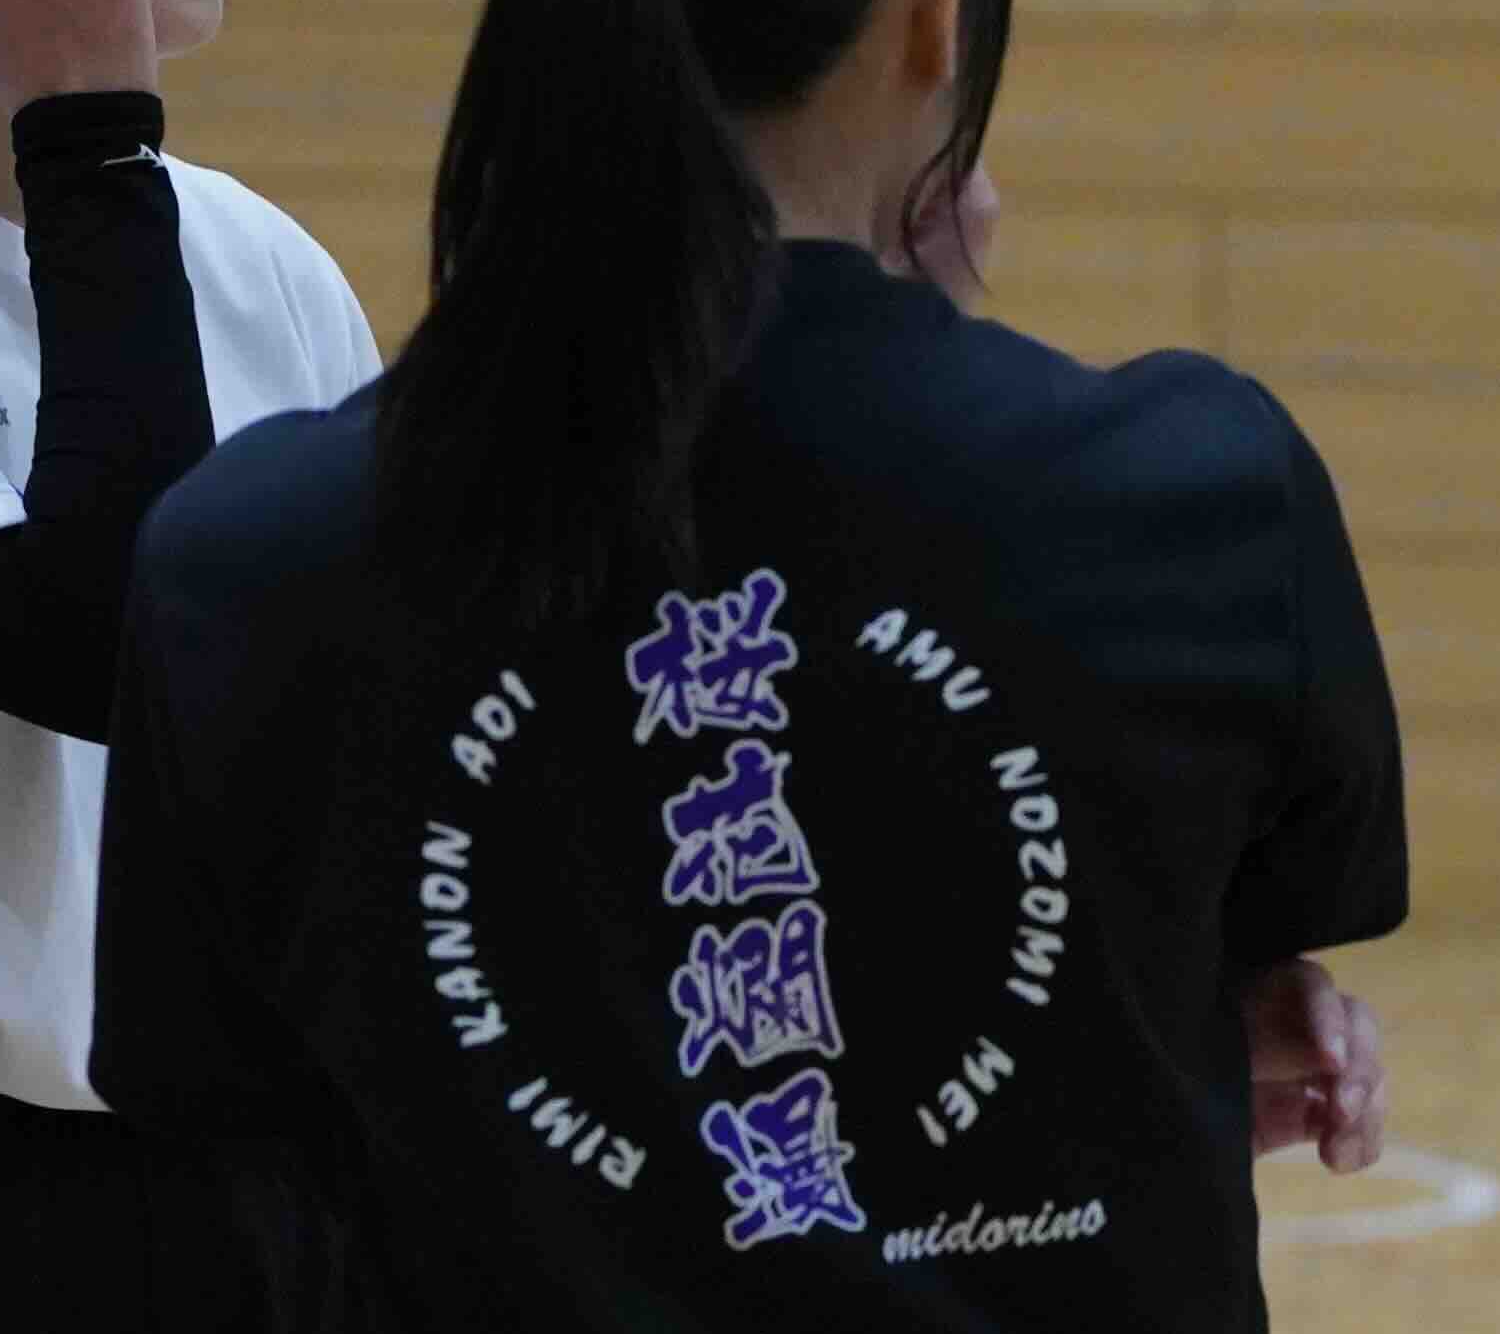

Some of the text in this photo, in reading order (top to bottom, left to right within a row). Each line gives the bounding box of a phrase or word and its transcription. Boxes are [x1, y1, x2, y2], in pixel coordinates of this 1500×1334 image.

[419, 670, 646, 1189] RIMI KANON AOI
[625, 567, 867, 1251] 桜花爛漫
[856, 608, 1069, 1146] AMU NOZOMI MEI
[882, 1198, 1107, 1265] midorino
